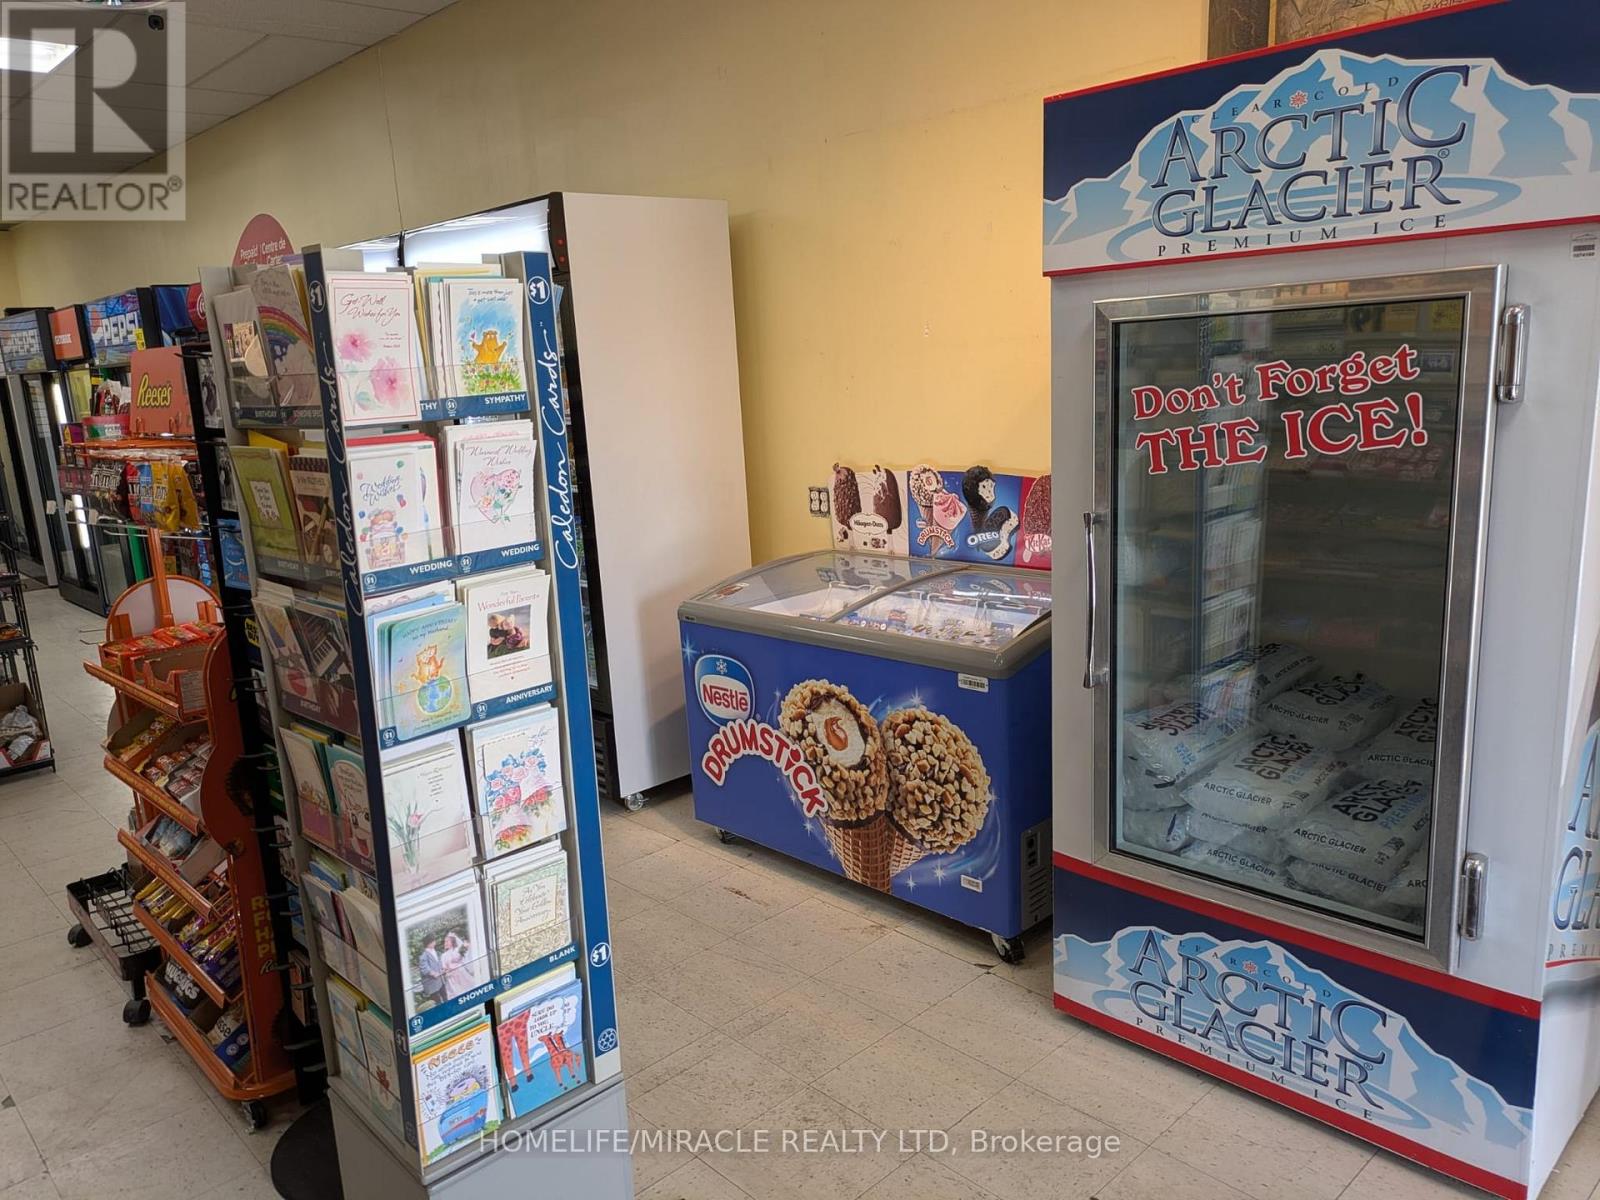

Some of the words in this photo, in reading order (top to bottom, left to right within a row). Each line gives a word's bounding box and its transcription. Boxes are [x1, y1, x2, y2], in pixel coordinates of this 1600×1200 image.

[1191, 97, 1283, 124] CLEAR
[1314, 76, 1400, 102] COLD
[1151, 65, 1471, 189] ARCTIC
[1157, 226, 1338, 257] PREMIUM
[1372, 214, 1447, 235] ICE
[529, 281, 546, 300] $1
[101, 310, 140, 347] PEPSI
[137, 374, 172, 408] Reese's
[537, 328, 566, 437] Cards
[1130, 372, 1247, 420] Don't
[1254, 343, 1421, 402] Forget
[319, 340, 347, 465] Cards
[484, 393, 526, 405] SYMPATHY
[1135, 416, 1268, 475] THE
[1280, 392, 1429, 460] ICE!
[547, 440, 579, 569] Caledon
[501, 544, 540, 558] WEDDING
[967, 531, 999, 546] OREO
[409, 559, 453, 576] WEDDING
[505, 685, 553, 704] ANNIVERSARY
[1367, 753, 1402, 763] ARCTIC
[1204, 781, 1236, 798] ARCTIC
[1236, 790, 1272, 805] GLACIER
[1294, 828, 1327, 847] ARCTIC
[1327, 838, 1367, 855] GLACIER
[1206, 848, 1239, 865] ARCTIC
[1239, 859, 1276, 878] GLACIER
[549, 945, 576, 963] BLANK
[592, 944, 607, 965] $1
[458, 983, 494, 1005] SHOWER
[1128, 928, 1388, 1061] ARCTIC
[1262, 968, 1332, 998] COLD
[1135, 1016, 1286, 1086] PREMIUM
[1313, 1088, 1373, 1122] ICE
